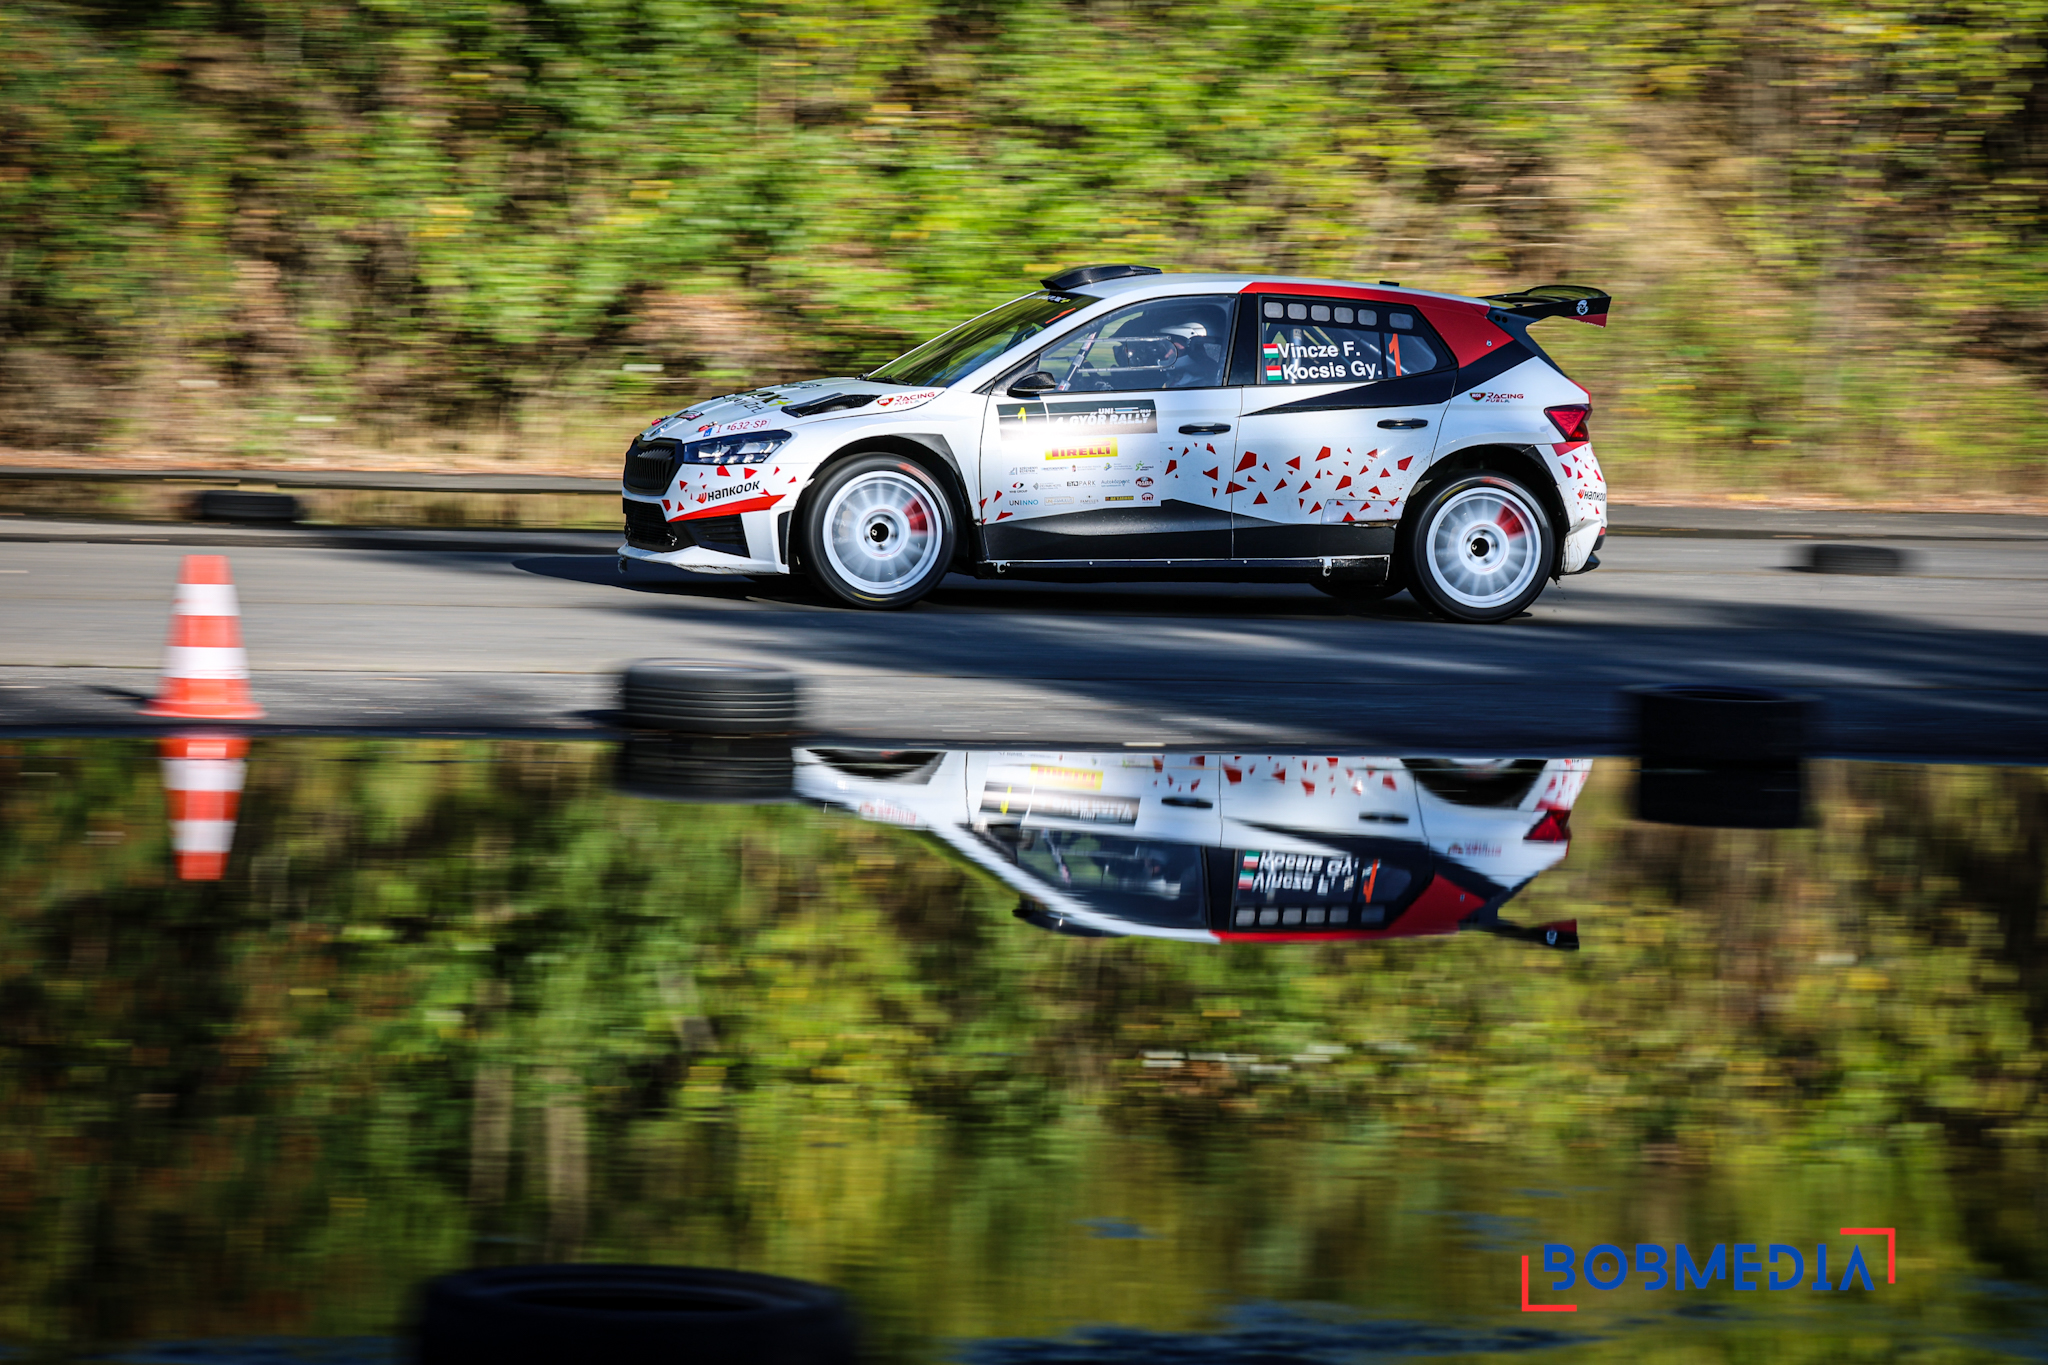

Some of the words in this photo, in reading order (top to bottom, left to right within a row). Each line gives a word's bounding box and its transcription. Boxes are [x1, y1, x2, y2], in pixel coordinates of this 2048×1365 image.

[1276, 342, 1339, 359] Vincze
[1343, 341, 1361, 357] F.
[1388, 333, 1402, 377] 1
[1282, 361, 1347, 380] Kocsis
[1350, 360, 1383, 380] Gy.
[896, 392, 935, 402] RACING
[1098, 407, 1114, 415] UNI
[1109, 412, 1151, 425] RALLY
